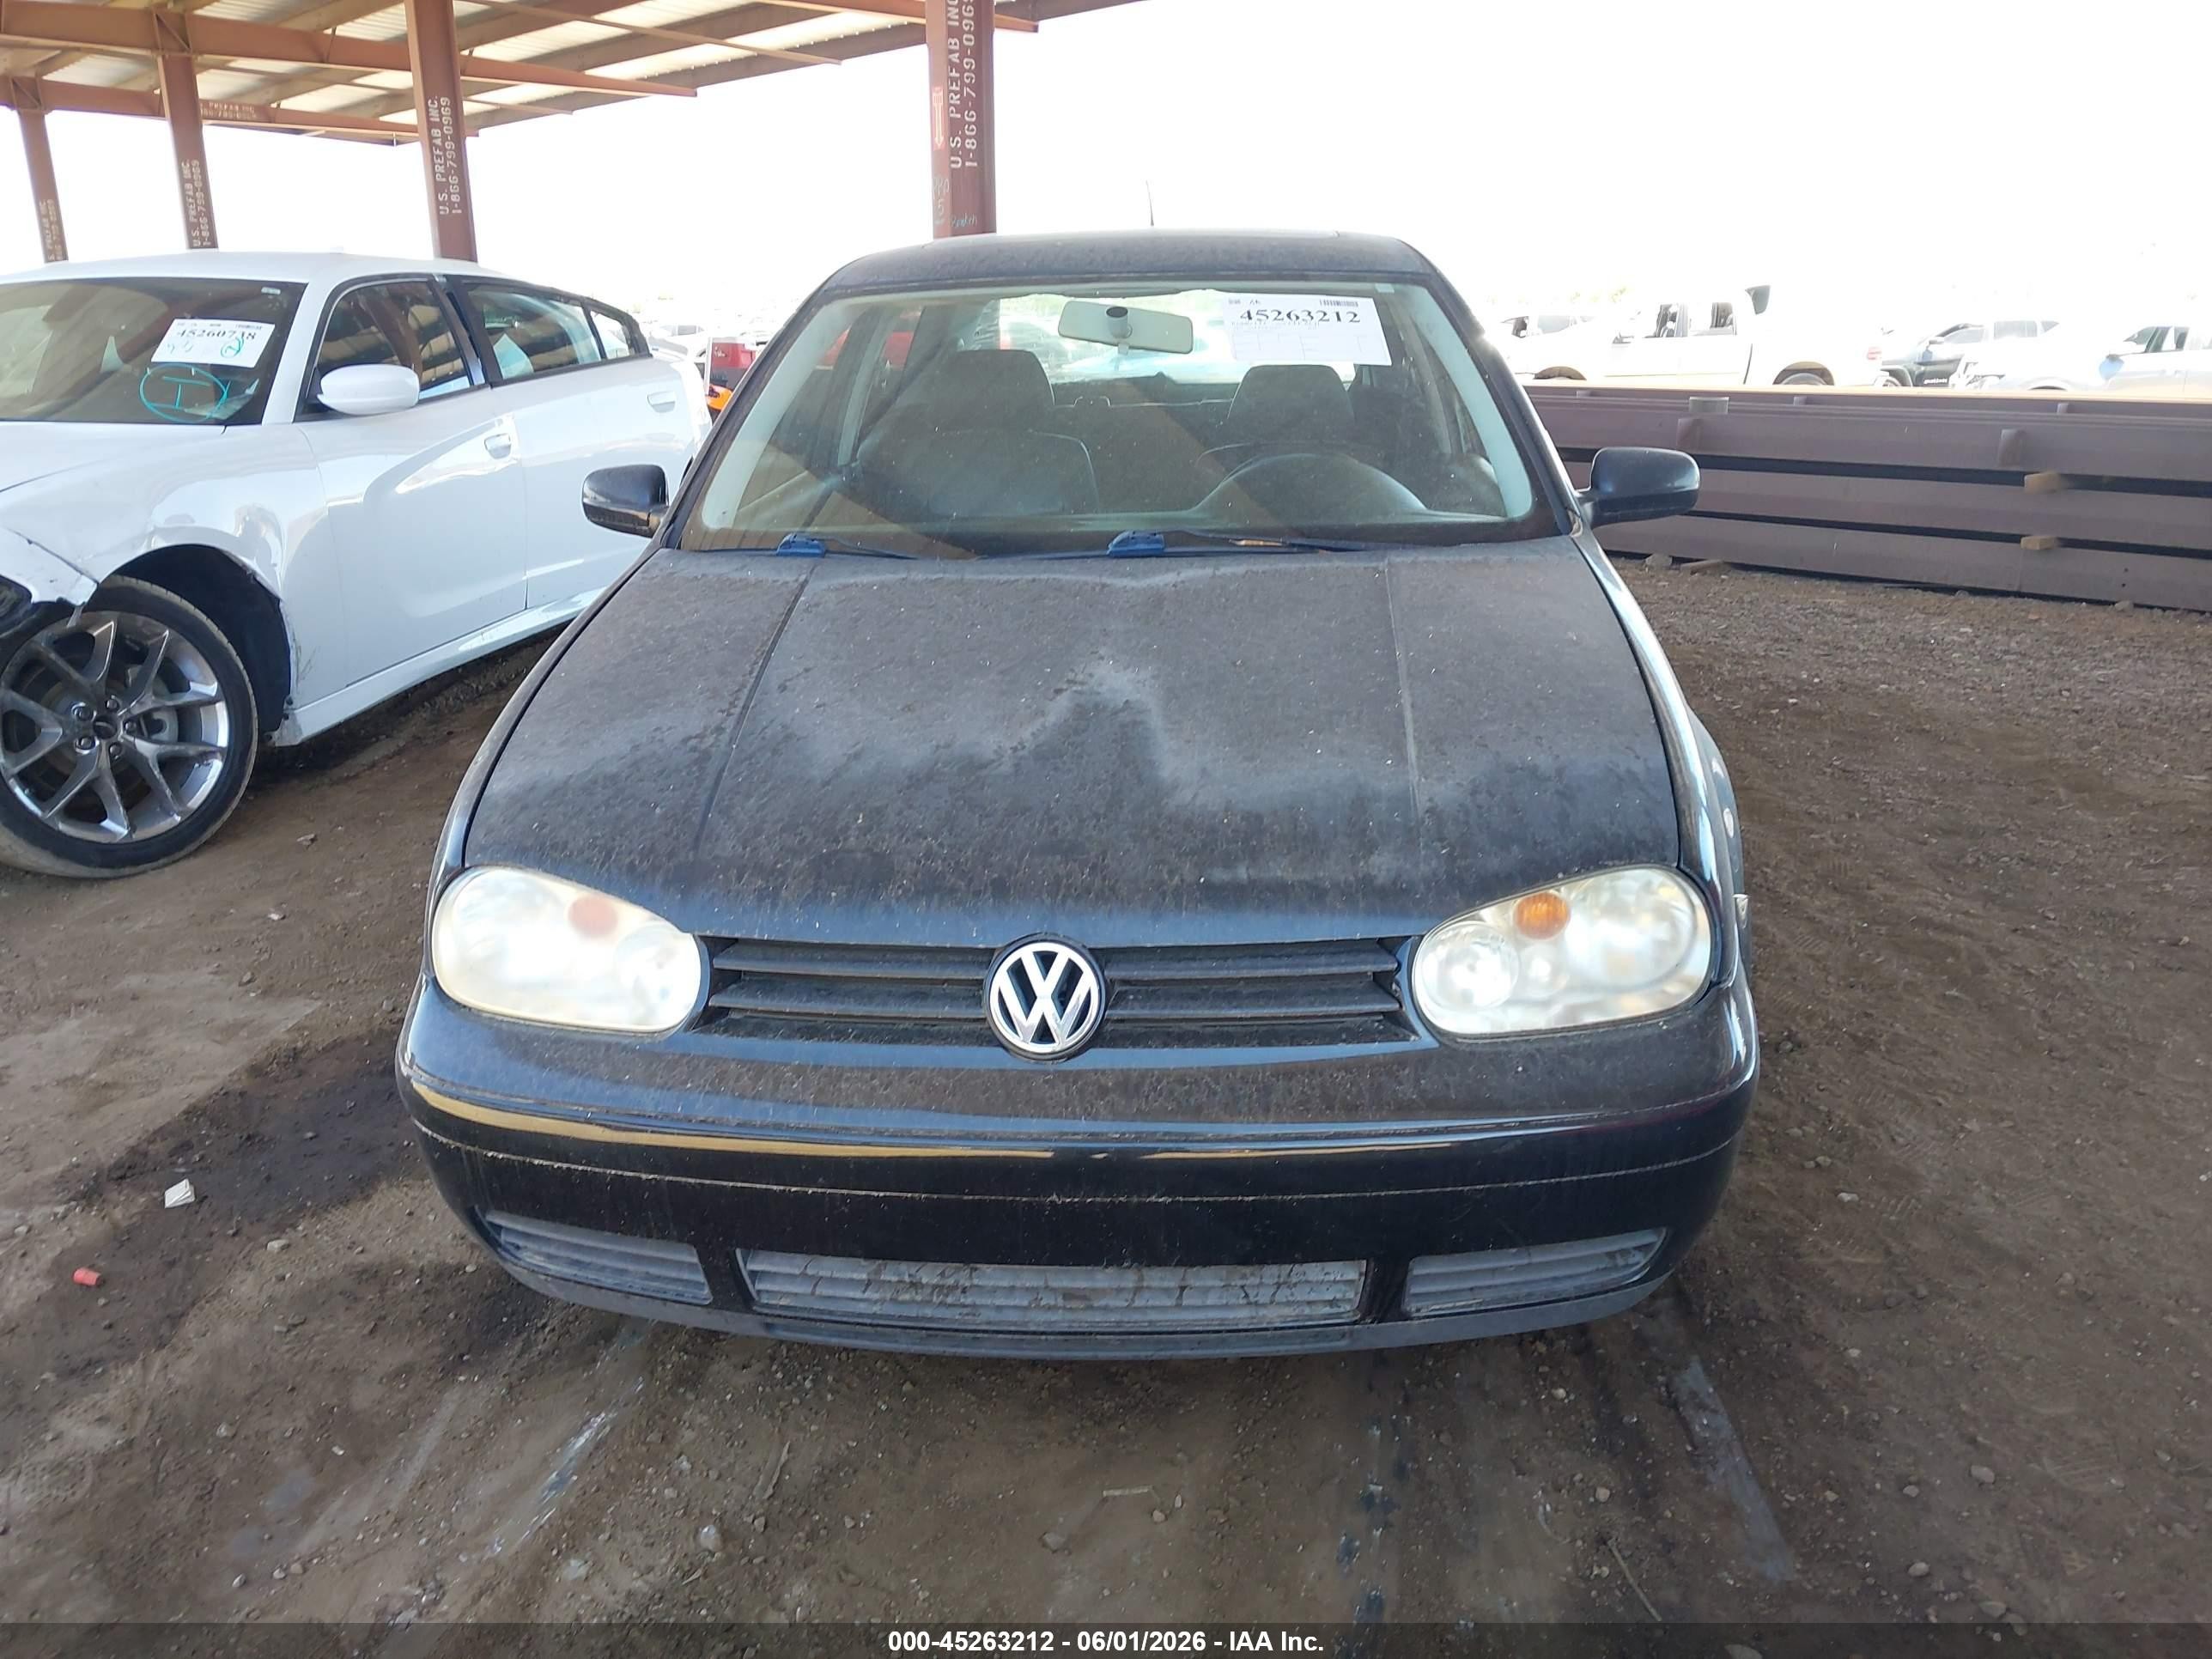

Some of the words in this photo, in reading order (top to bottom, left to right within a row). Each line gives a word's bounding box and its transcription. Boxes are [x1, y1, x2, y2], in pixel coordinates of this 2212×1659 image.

[947, 37, 961, 118] PREFAB
[962, 0, 978, 167] 1-866-799-096
[430, 127, 447, 182] PREFAB
[440, 96, 463, 215] 1-866-799-0969
[950, 130, 963, 169] U.S.
[438, 189, 450, 216] U.S.
[1240, 308, 1361, 324] 45263212
